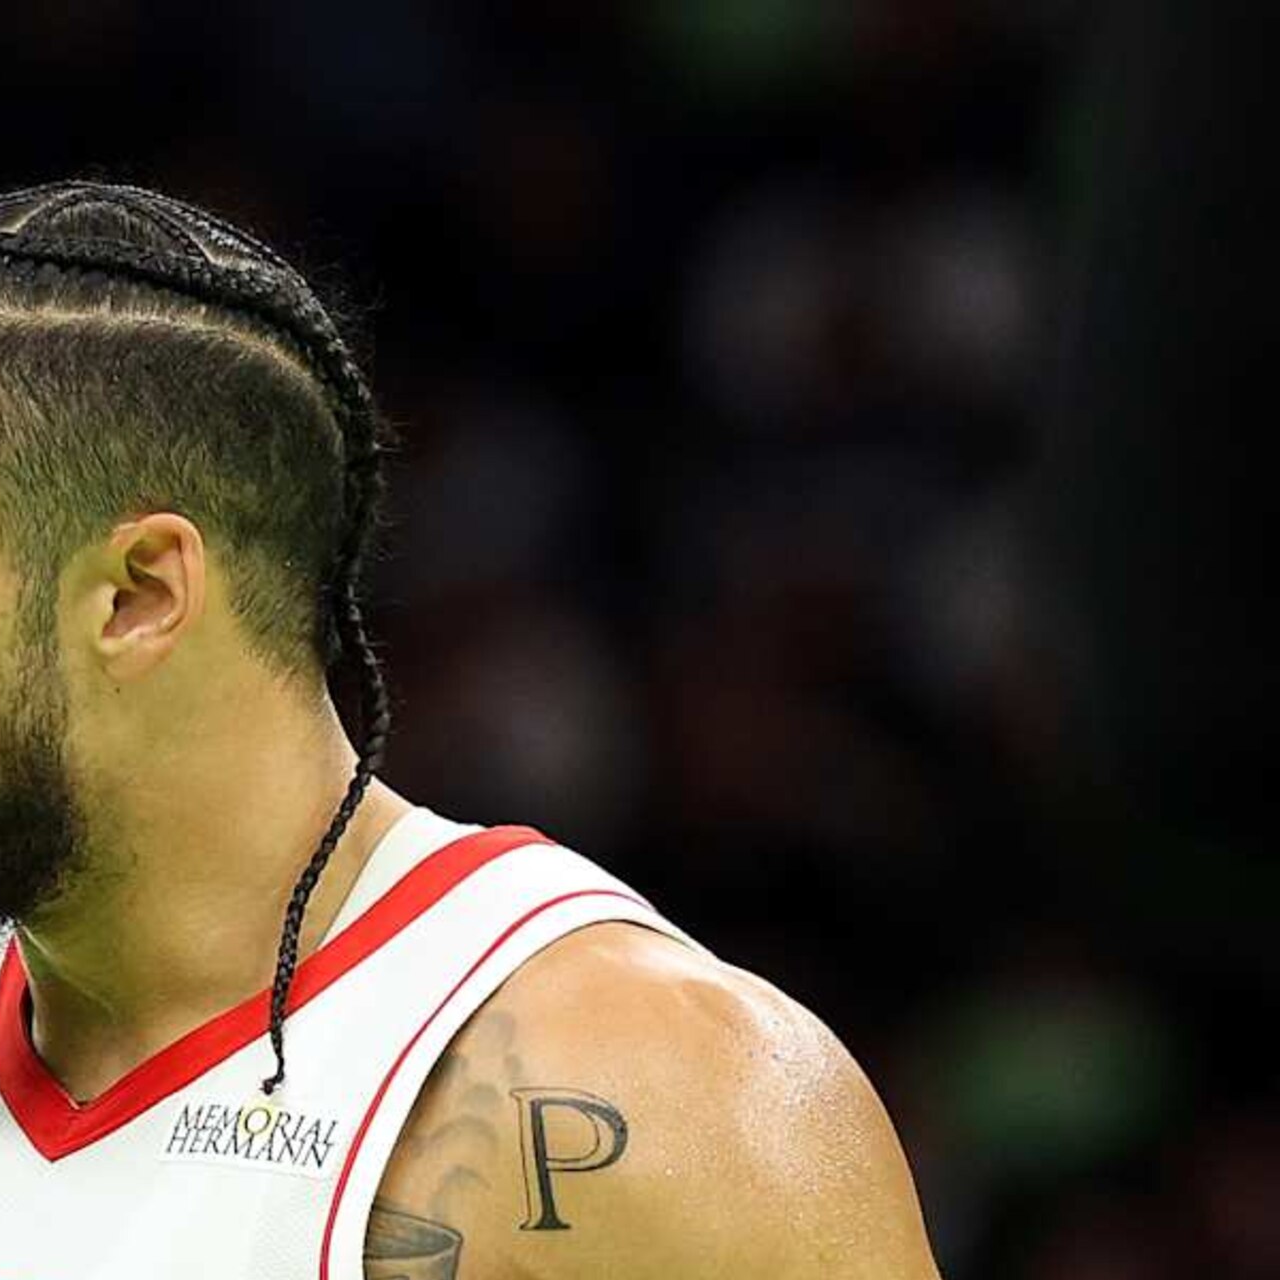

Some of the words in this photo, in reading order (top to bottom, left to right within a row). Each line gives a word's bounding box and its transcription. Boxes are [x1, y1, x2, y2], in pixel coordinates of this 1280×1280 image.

[173, 1104, 338, 1147] MEMORIAL
[165, 1126, 334, 1169] HERMANN
[510, 1087, 628, 1230] P
